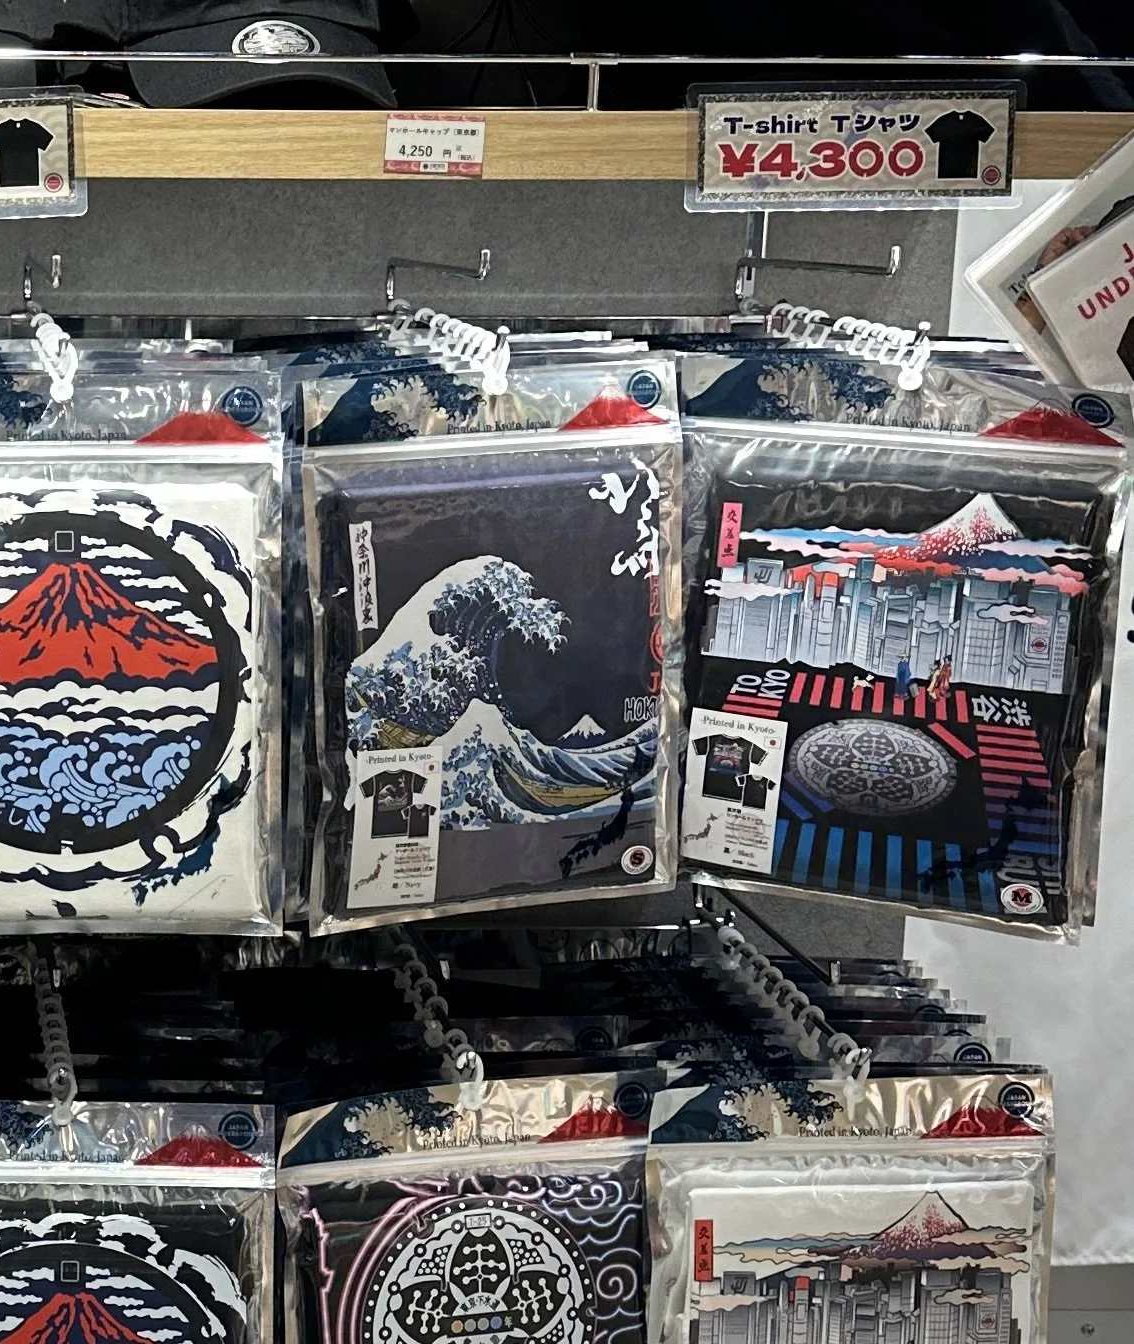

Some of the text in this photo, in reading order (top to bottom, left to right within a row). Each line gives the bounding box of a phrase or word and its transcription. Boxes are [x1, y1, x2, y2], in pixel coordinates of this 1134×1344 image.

[724, 113, 921, 135] T-shirt Tシャツ
[398, 144, 452, 159] 4,250 円
[719, 140, 925, 182] ¥4,300
[730, 674, 763, 695] TO
[756, 668, 791, 701] KYO
[972, 694, 1034, 728] 渋谷
